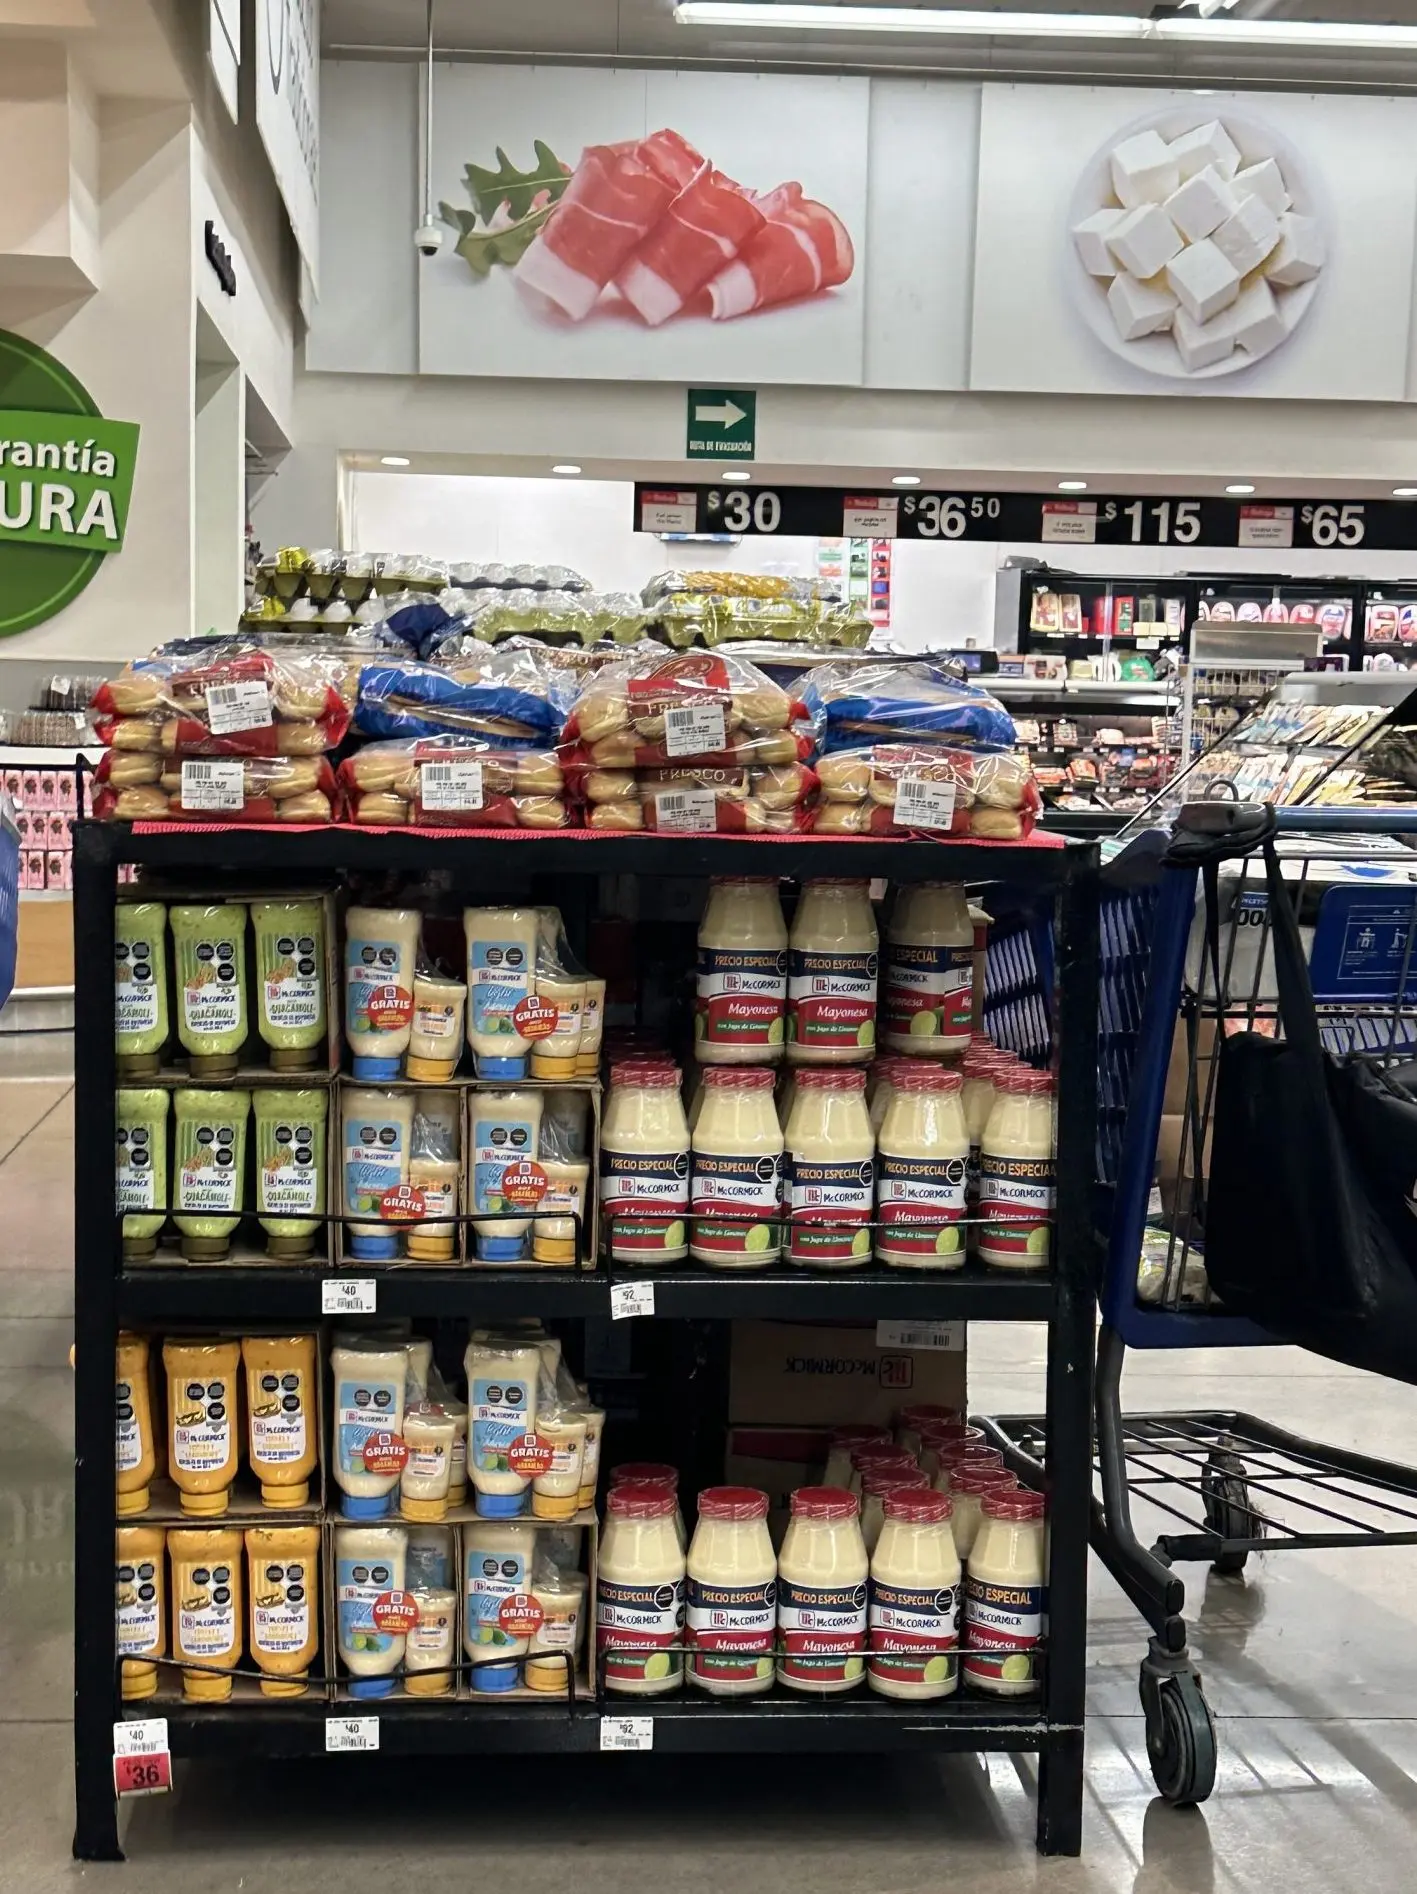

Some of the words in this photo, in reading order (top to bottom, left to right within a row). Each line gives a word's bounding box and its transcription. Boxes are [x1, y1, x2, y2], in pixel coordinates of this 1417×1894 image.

[371, 1000, 410, 1010] GRATIS
[728, 1003, 778, 1016] Mayonesa
[516, 1008, 554, 1022] GRATIS
[817, 1005, 868, 1020] Mayonesa
[718, 1162, 755, 1172] ESPECIAL
[505, 1176, 545, 1186] GRATIS
[908, 1189, 954, 1198] McCORMICK
[384, 1198, 422, 1212] GRATIS
[366, 1446, 406, 1457] GRATIS
[511, 1448, 550, 1458] GRATIS
[618, 1590, 654, 1602] ESPECIAL
[898, 1594, 934, 1605] ESPECIAL
[986, 1588, 1032, 1604] ESPECIAL
[376, 1604, 416, 1616] GRATIS
[502, 1608, 540, 1618] GRATIS
[616, 1614, 662, 1624] McCORMICK
[896, 1618, 941, 1628] McCORMICK
[977, 1610, 1022, 1626] McCORMICK
[968, 1630, 1016, 1649] Mayonesa
